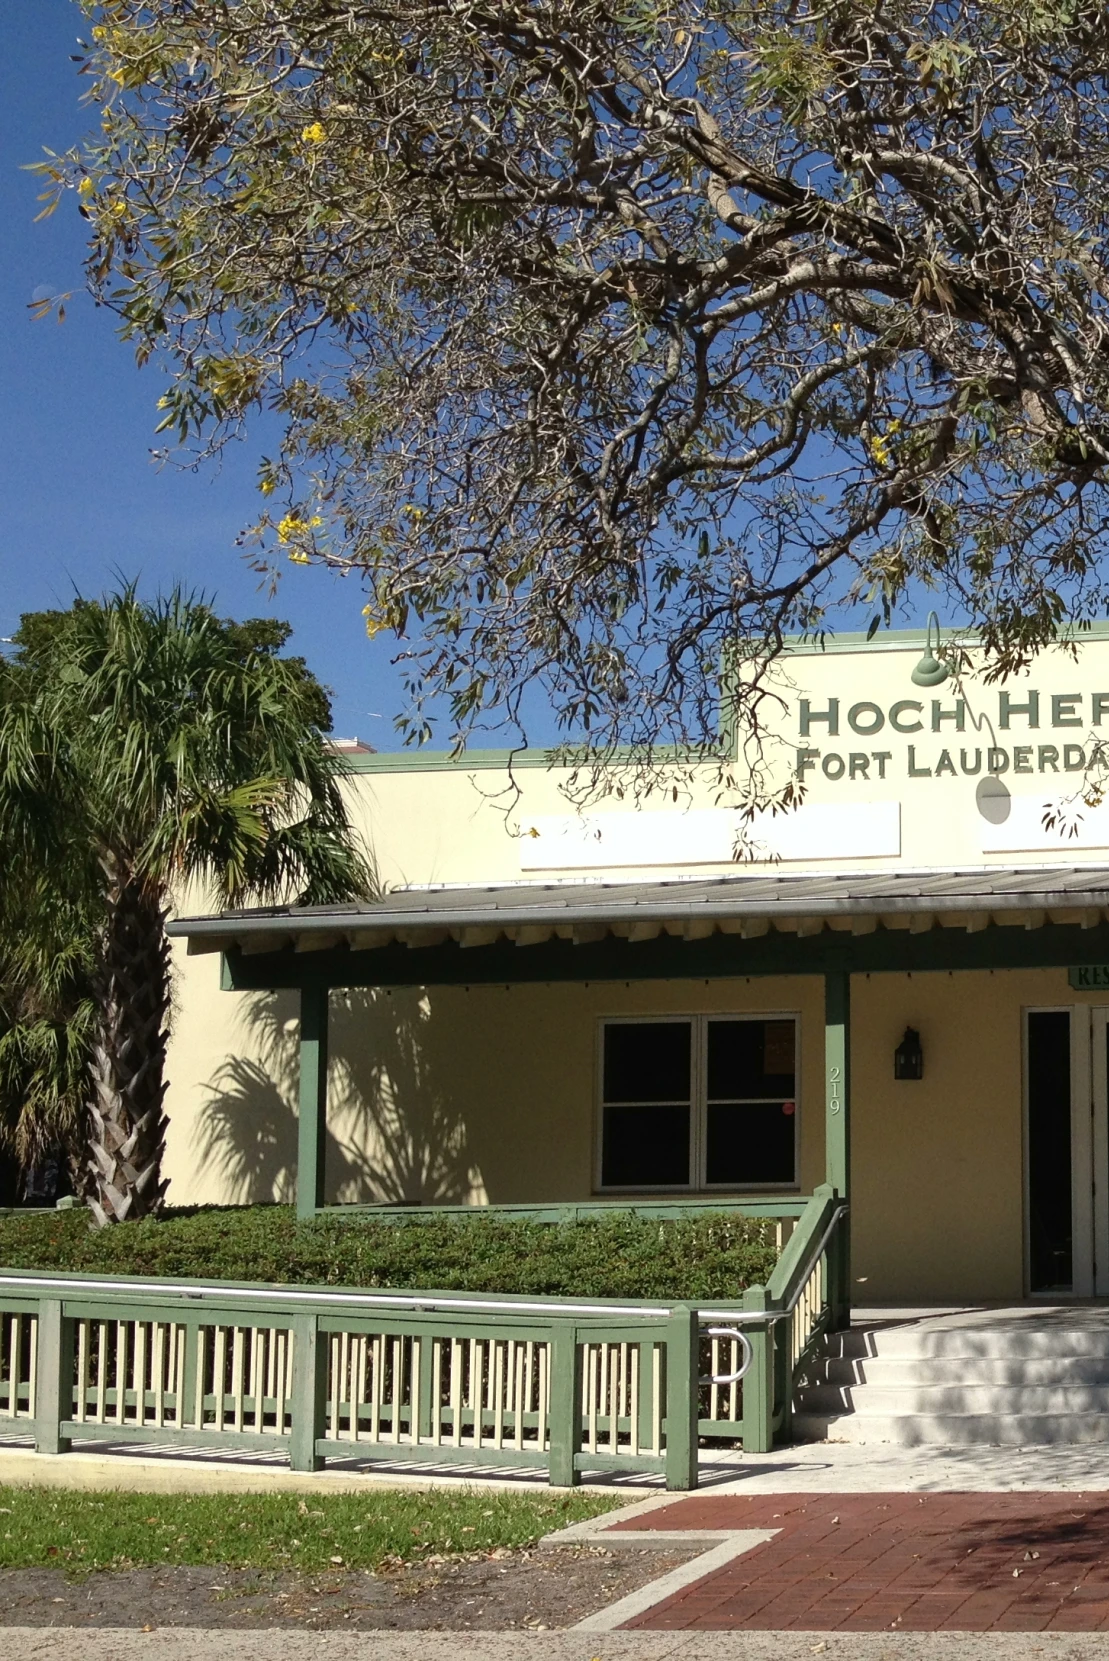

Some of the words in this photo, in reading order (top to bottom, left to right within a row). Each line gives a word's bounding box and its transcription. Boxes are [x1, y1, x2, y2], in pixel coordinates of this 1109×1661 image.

[799, 698, 966, 738] HOCH
[796, 748, 892, 782] FORT
[830, 1066, 840, 1116] 219
